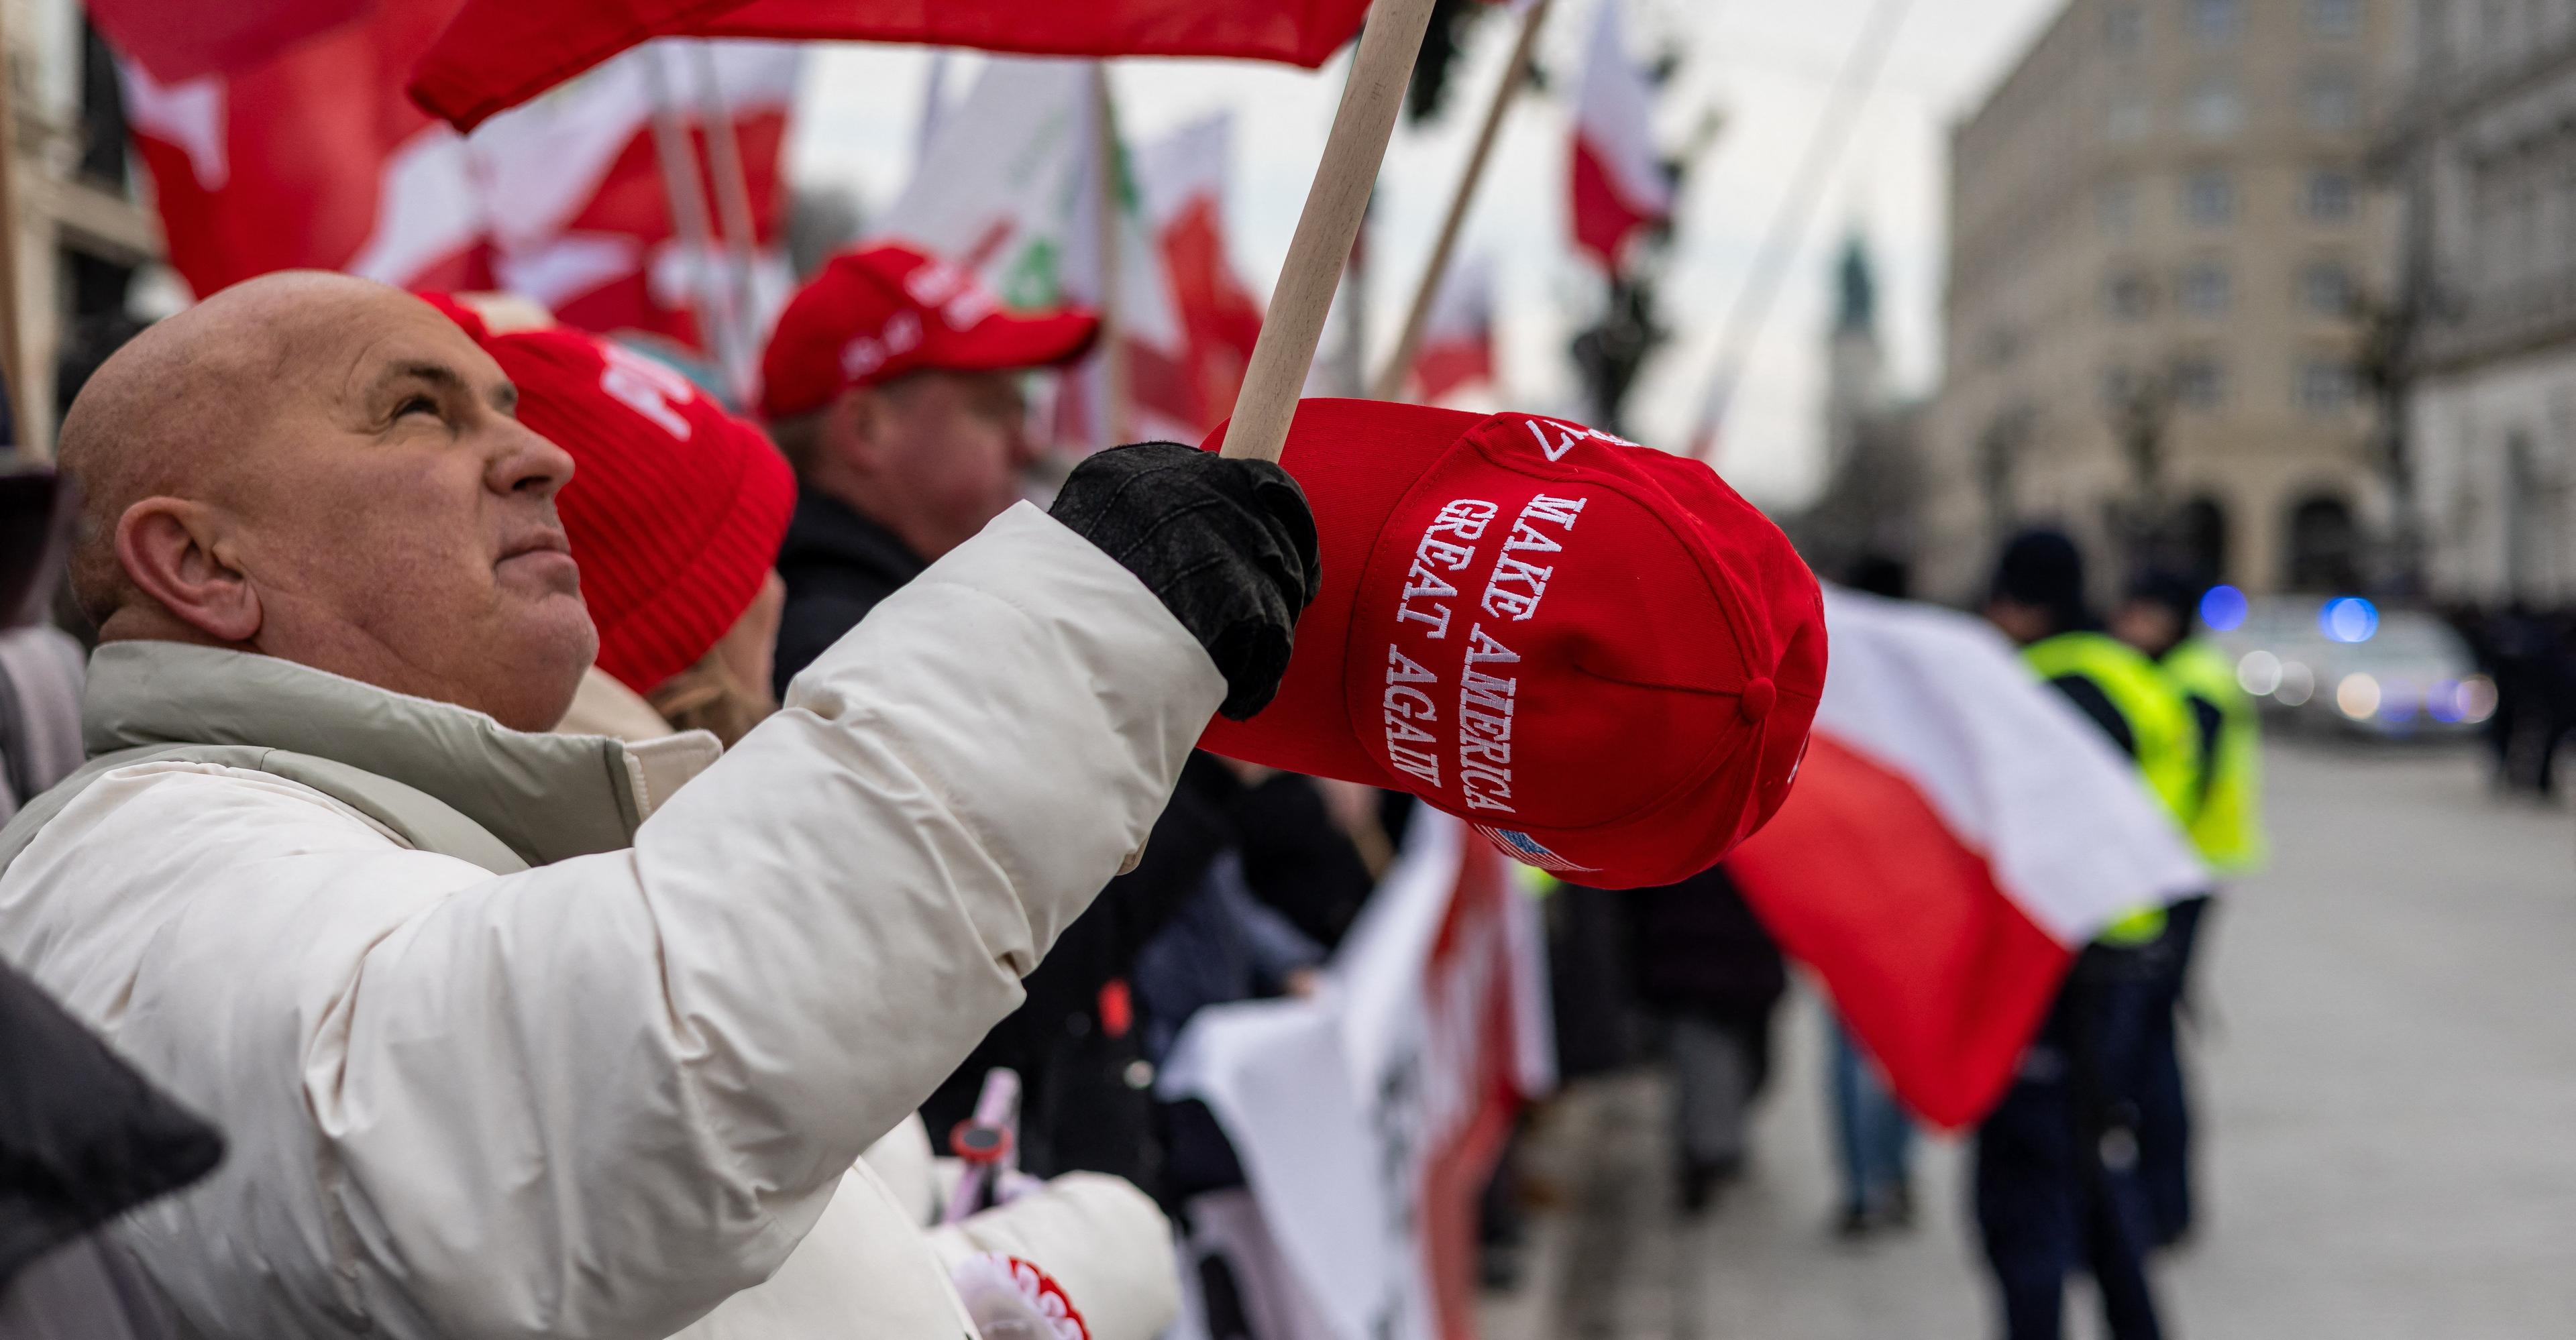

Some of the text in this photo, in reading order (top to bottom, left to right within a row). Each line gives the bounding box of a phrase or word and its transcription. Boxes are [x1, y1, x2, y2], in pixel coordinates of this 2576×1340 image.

[1383, 499, 1498, 788] GREAT AGAIN
[1481, 494, 1587, 621] MAKE
[1459, 622, 1521, 813] AMERICA
